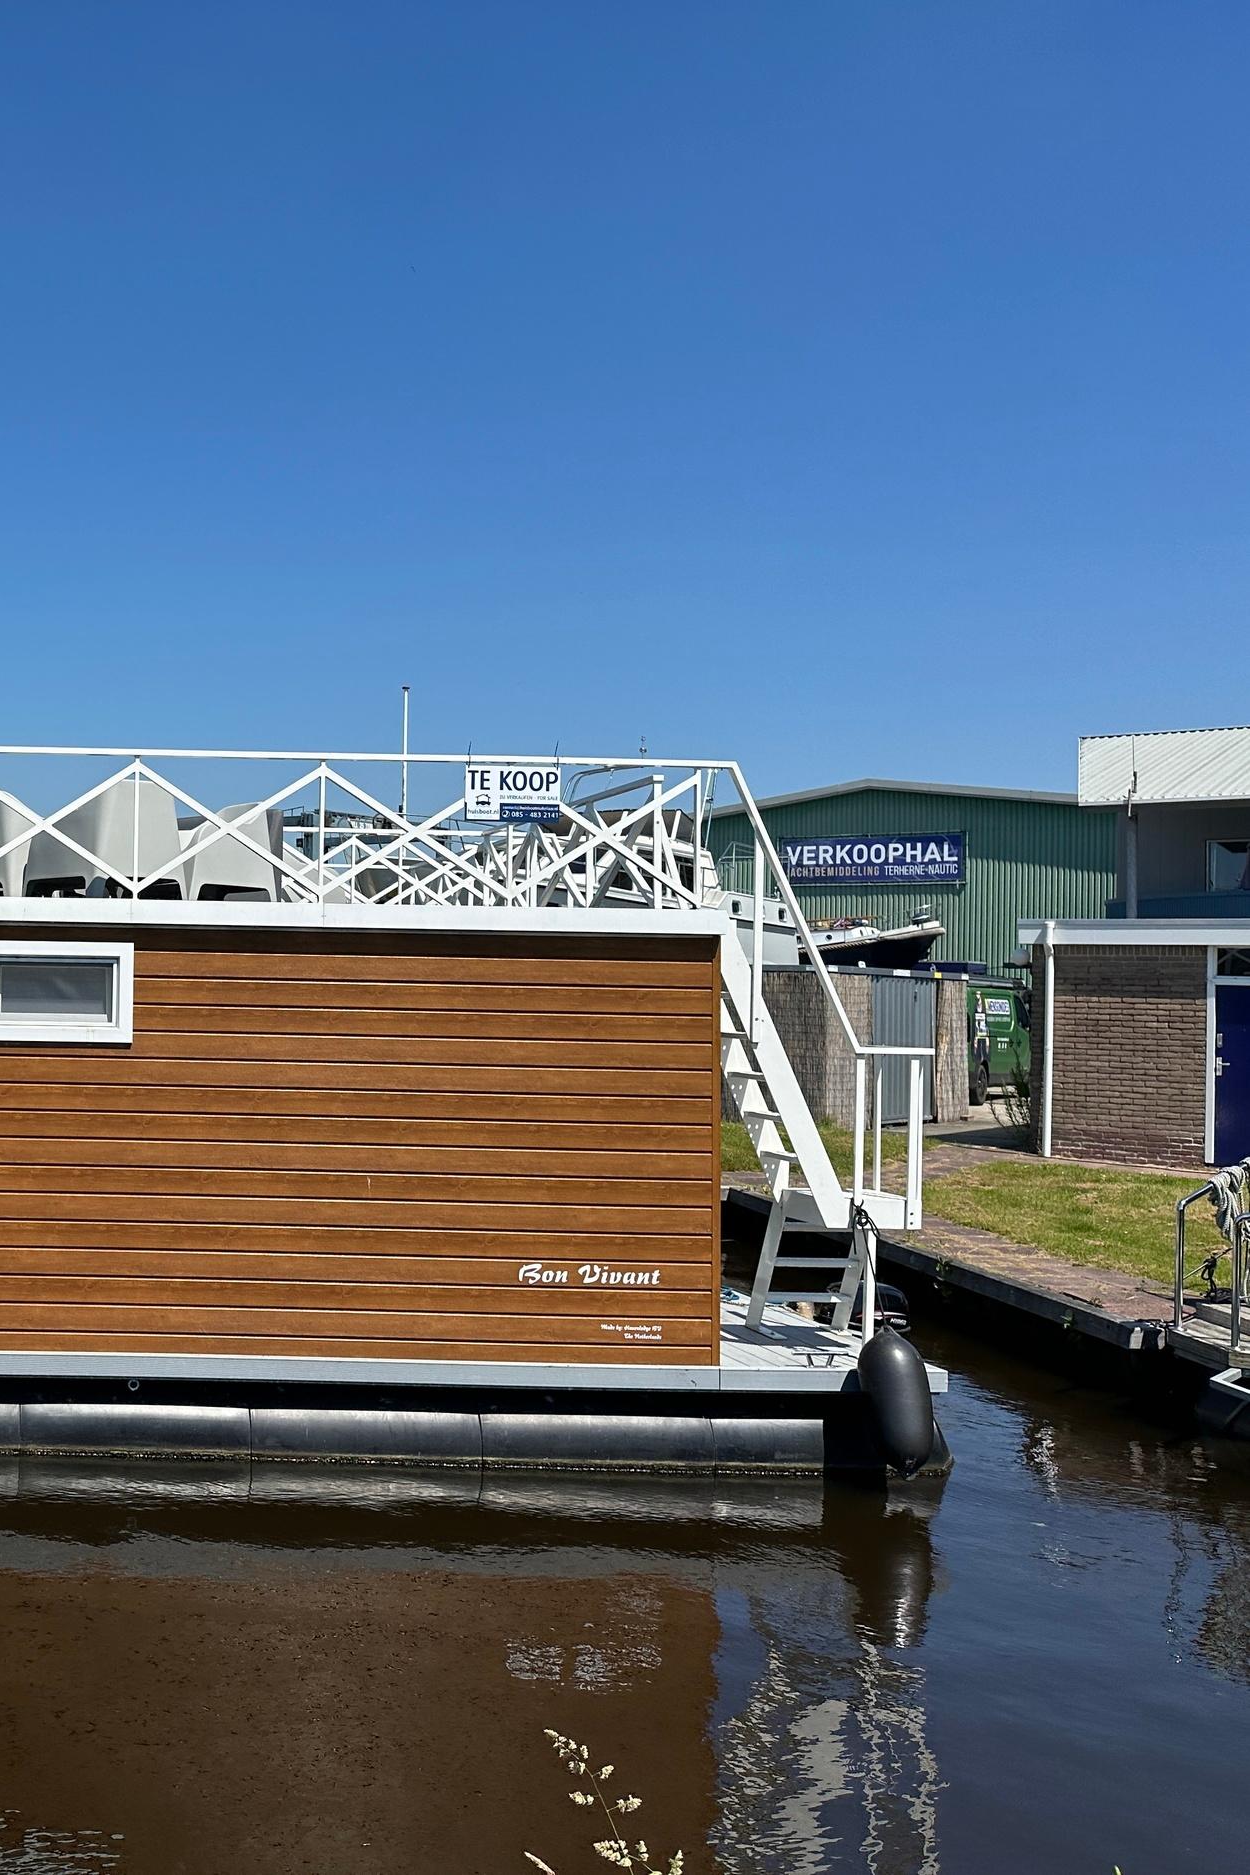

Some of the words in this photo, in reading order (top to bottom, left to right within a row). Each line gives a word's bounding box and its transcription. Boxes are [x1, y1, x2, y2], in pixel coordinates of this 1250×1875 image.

[468, 770, 491, 790] TE
[499, 770, 559, 792] KOOP
[787, 841, 958, 866] VERKOOPHAL
[787, 866, 880, 877] ACHTBEMIDDELING
[518, 1263, 568, 1284] Bon
[578, 1264, 661, 1285] Vivant
